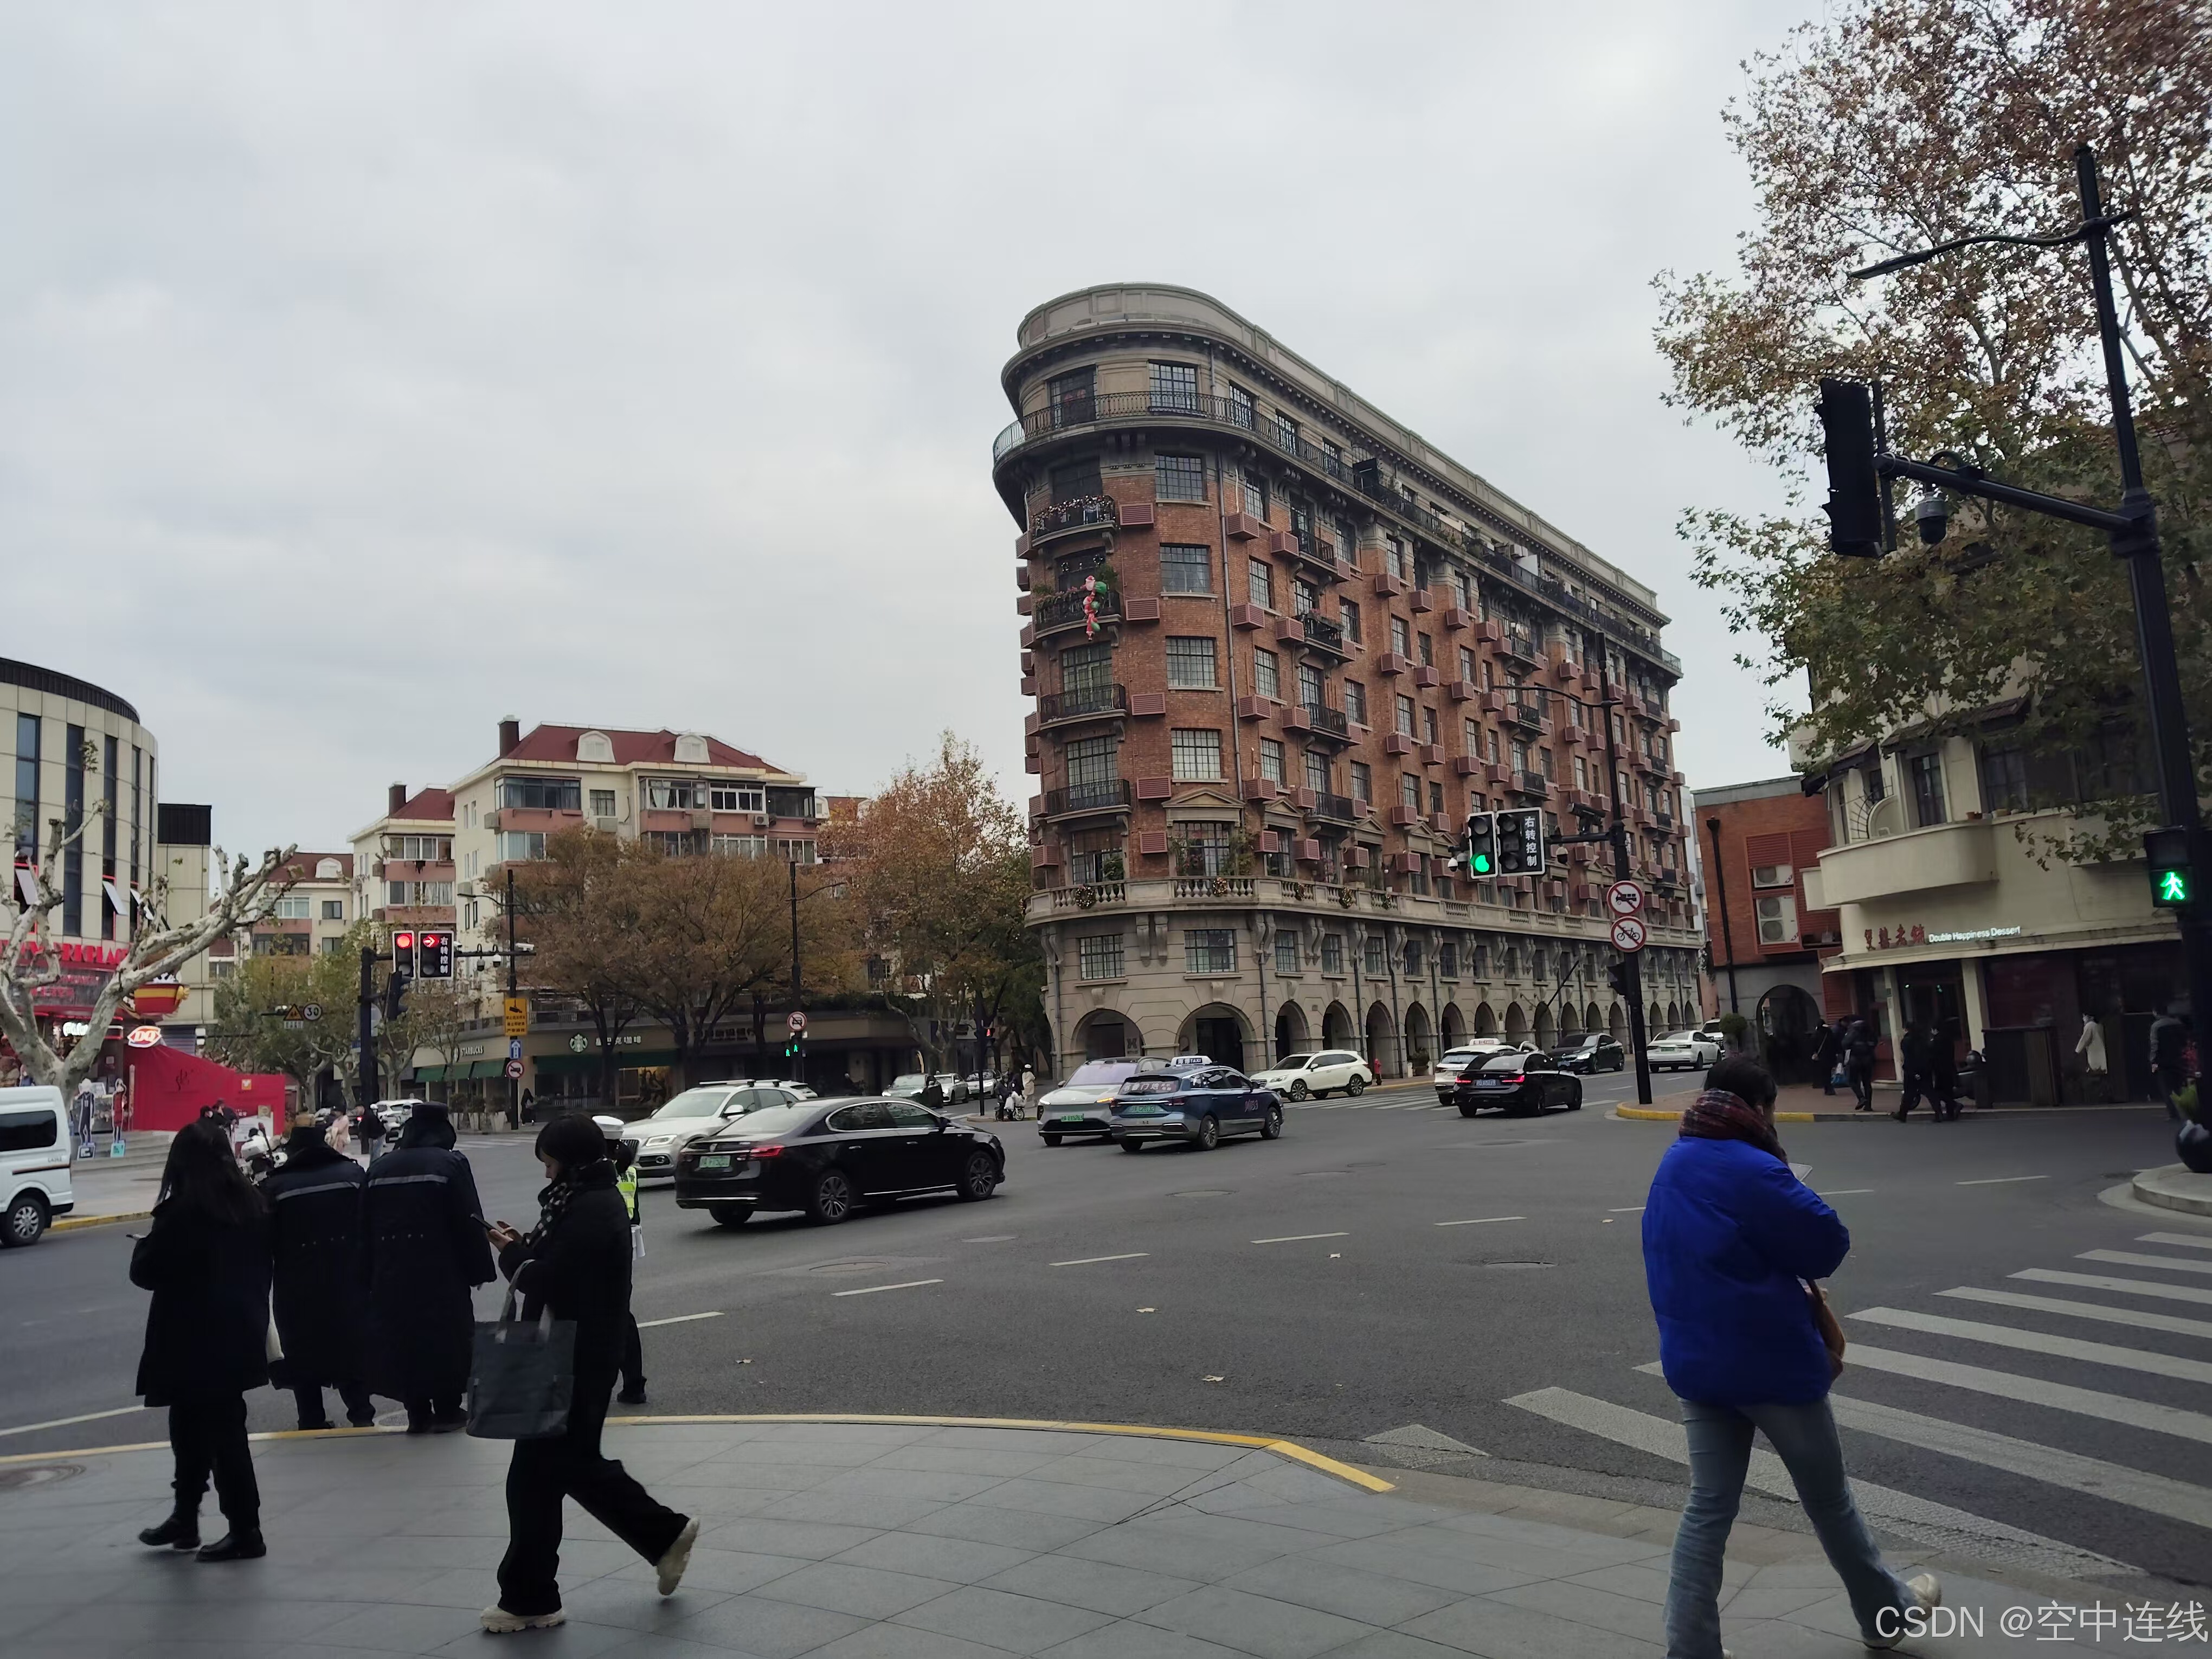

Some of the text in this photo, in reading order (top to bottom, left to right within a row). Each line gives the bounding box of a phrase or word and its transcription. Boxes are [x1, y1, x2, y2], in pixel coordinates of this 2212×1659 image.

[1525, 816, 1537, 867] 右转控制
[1928, 925, 2021, 943] Double Happiness Dessert
[307, 1007, 319, 1017] 30
[135, 1030, 156, 1041] DQ
